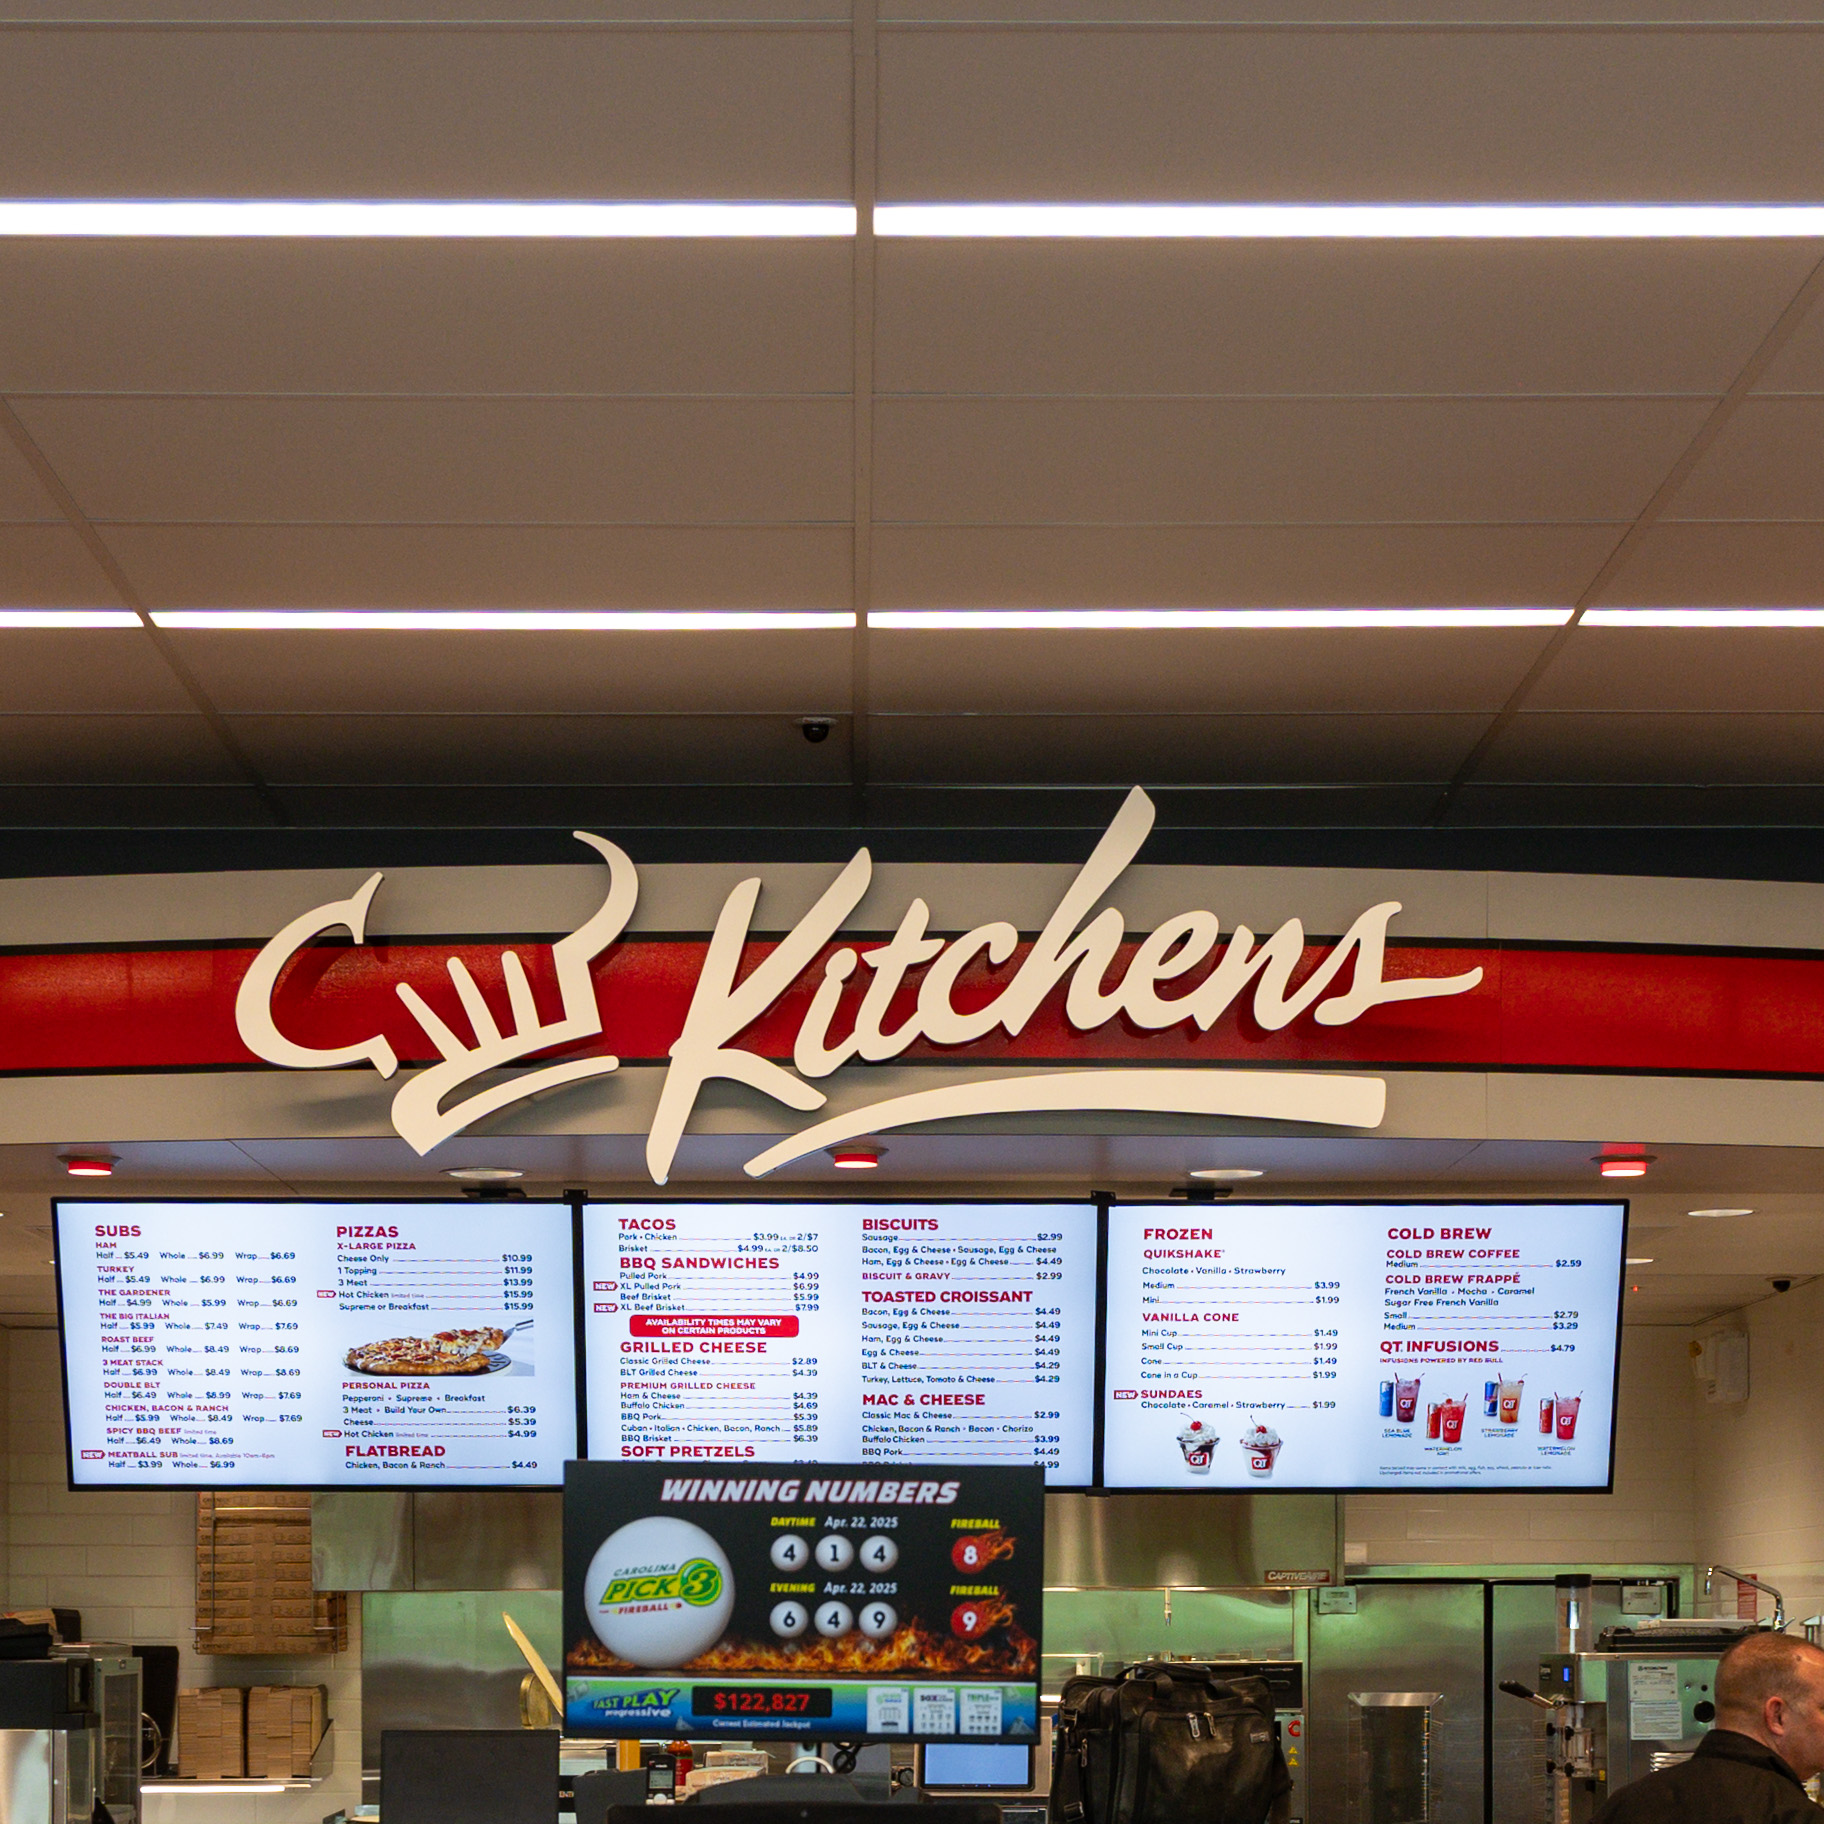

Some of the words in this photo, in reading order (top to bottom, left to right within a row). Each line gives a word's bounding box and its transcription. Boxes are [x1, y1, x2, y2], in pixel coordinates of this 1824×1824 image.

[645, 783, 1484, 1185] Kitchens
[618, 1219, 676, 1230] TACOS
[863, 1219, 938, 1230] BISCUITS
[95, 1225, 141, 1237] SUBS
[337, 1226, 399, 1237] PIZZAS
[1144, 1229, 1213, 1240] FROZEN
[1388, 1228, 1434, 1239] COLD
[1441, 1228, 1492, 1239] BREW
[124, 1252, 149, 1260] $5.49
[199, 1252, 224, 1260] $6.99
[271, 1252, 295, 1260] $6.69
[370, 1255, 389, 1263] Only
[1387, 1250, 1422, 1258] COLD
[1426, 1250, 1464, 1258] BREW
[1469, 1250, 1520, 1258] COFFEE
[620, 1258, 656, 1270] BBQ
[662, 1258, 779, 1268] SANDWICHES
[1234, 1267, 1285, 1276] Strawberry
[862, 1291, 935, 1302] TOASTED
[940, 1291, 1033, 1302] CROISSANT
[1143, 1313, 1199, 1322] VANILLA
[1204, 1313, 1239, 1322] CONE
[620, 1342, 693, 1353] GRILLED
[700, 1342, 767, 1353] CHEESE
[1407, 1341, 1499, 1352] INFUSIONS
[863, 1394, 898, 1405] MAC
[904, 1394, 915, 1405] &
[920, 1394, 985, 1405] CHEESE
[1141, 1390, 1202, 1398] SUNDAES
[345, 1446, 446, 1457] FLATBREAD
[621, 1446, 665, 1457] SOFT
[670, 1446, 755, 1457] PRETZELS
[661, 1479, 801, 1502] WINNING
[805, 1479, 961, 1504] NUMBERS
[770, 1517, 817, 1527] DAYTIME
[825, 1516, 848, 1529] Apr.
[850, 1517, 867, 1528] 22,
[870, 1517, 899, 1528] 2025
[950, 1519, 1001, 1529] FIREBALL
[783, 1544, 795, 1561] 4
[830, 1544, 839, 1562] 1
[873, 1545, 886, 1562] 4
[964, 1545, 977, 1564] 8
[607, 1578, 678, 1600] PICK
[681, 1566, 718, 1598] 3
[770, 1583, 815, 1592] EVENING
[823, 1582, 847, 1595] Apr.
[849, 1583, 866, 1594] 22,
[869, 1583, 897, 1594] 2025
[950, 1585, 1000, 1595] FIREBALL
[783, 1611, 796, 1627] 6
[827, 1611, 840, 1628] 4
[873, 1611, 885, 1628] 9
[963, 1612, 976, 1631] 9
[713, 1693, 810, 1712] $122,827
